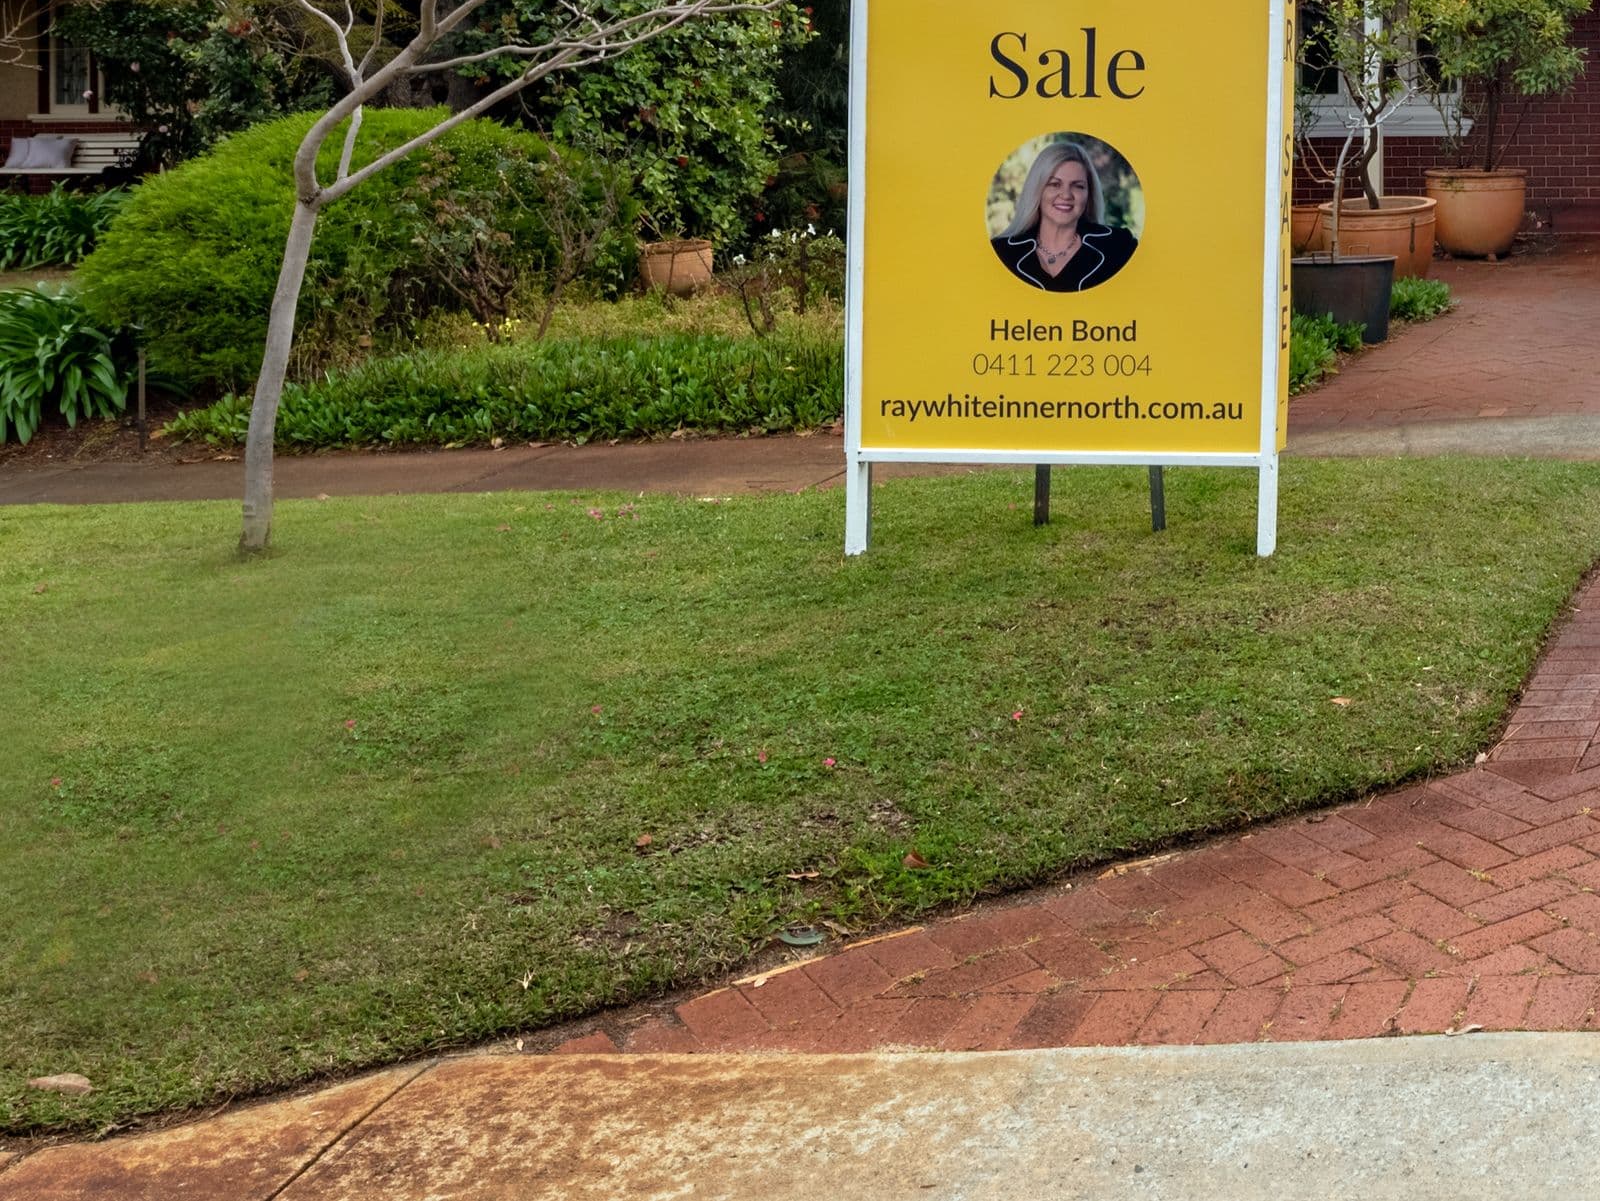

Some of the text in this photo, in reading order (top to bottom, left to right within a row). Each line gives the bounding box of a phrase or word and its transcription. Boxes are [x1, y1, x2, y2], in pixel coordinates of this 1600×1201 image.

[988, 26, 1146, 100] Sale
[1280, 133, 1291, 349] SALE
[989, 318, 1138, 343] Helen Bond
[972, 352, 1154, 377] 0411 223 004
[880, 393, 1244, 424] raywhiteinnernorth.com.au
